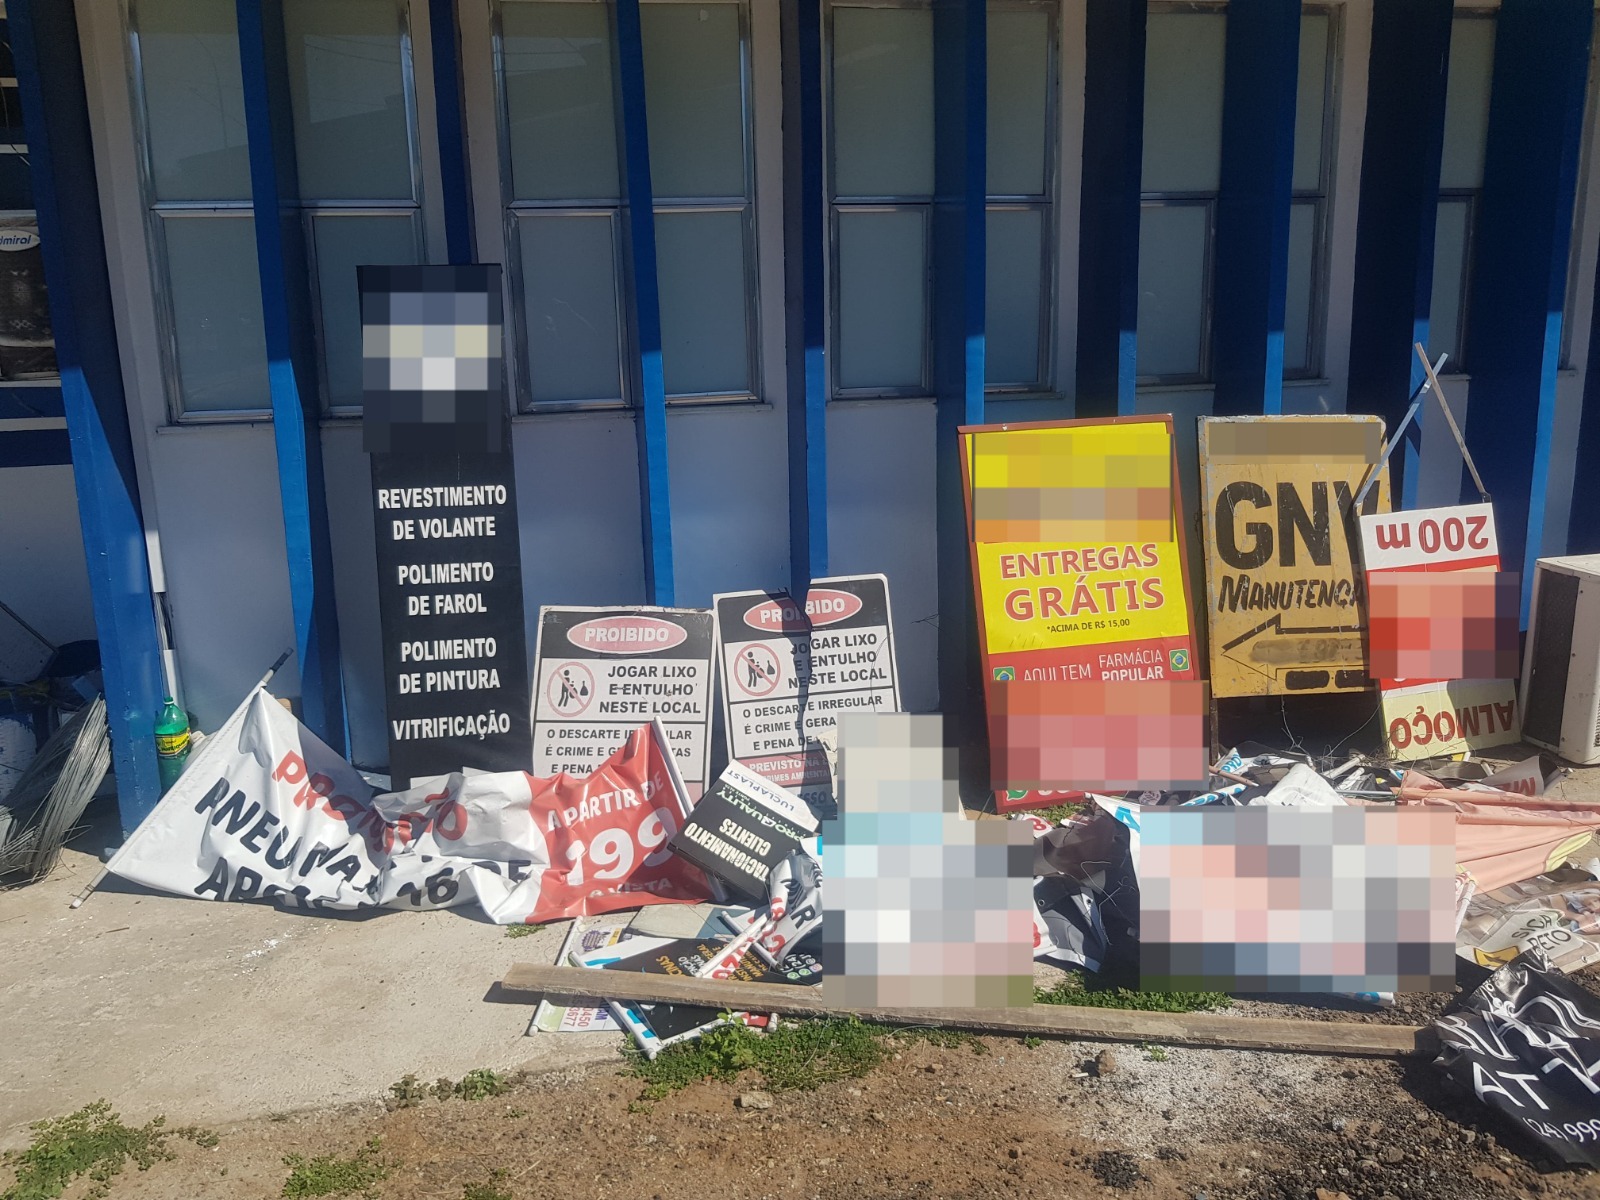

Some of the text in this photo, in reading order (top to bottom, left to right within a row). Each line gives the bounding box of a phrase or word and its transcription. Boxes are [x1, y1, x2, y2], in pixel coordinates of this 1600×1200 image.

[378, 484, 507, 509] REVESTIMENTO
[393, 516, 496, 540] DE VOLANTE
[1418, 515, 1490, 553] 200
[1000, 543, 1159, 579] ENTREGAS
[398, 561, 494, 585] POLIMENTO
[408, 593, 487, 616] DE FAROL
[1004, 575, 1165, 621] GRÁTIS
[760, 598, 845, 624] PROIBIDO
[584, 627, 669, 642] PROIBIDO
[1081, 622, 1093, 630] DE
[1095, 620, 1106, 629] R$
[1108, 618, 1130, 628] 15,00
[401, 637, 496, 662] POLIMENTO
[790, 633, 877, 655] JOGAR LIXO
[794, 651, 877, 671] E ENTULHO
[1098, 647, 1163, 669] FARMÁCIA
[400, 668, 501, 694] DE PINTURA
[607, 666, 697, 678] JOGAR LIXO
[788, 668, 887, 689] NESTE LOCAL
[1060, 663, 1092, 680] TEM
[1101, 665, 1164, 681] POPULAR
[609, 683, 694, 696] E ENTULHO
[599, 701, 701, 714] NESTE LOCAL
[743, 695, 883, 718] O DESCARTE IRREGULAR
[392, 709, 511, 740] VITRIFICAÇÃO
[547, 729, 555, 739] O
[559, 729, 621, 739] DESCARTE
[755, 721, 791, 734] CRIME
[805, 717, 836, 728] GERA
[1389, 700, 1515, 749] ALMOÇO
[556, 746, 593, 757] CRIME
[597, 747, 604, 756] E
[753, 735, 813, 751] E PENA DE
[551, 764, 558, 774] E
[562, 764, 593, 774] PENA
[749, 759, 802, 772] PREVISTO
[563, 788, 642, 826] PARTIR
[641, 772, 664, 801] DE
[565, 806, 678, 886] 199
[719, 818, 771, 857] CLIENTES
